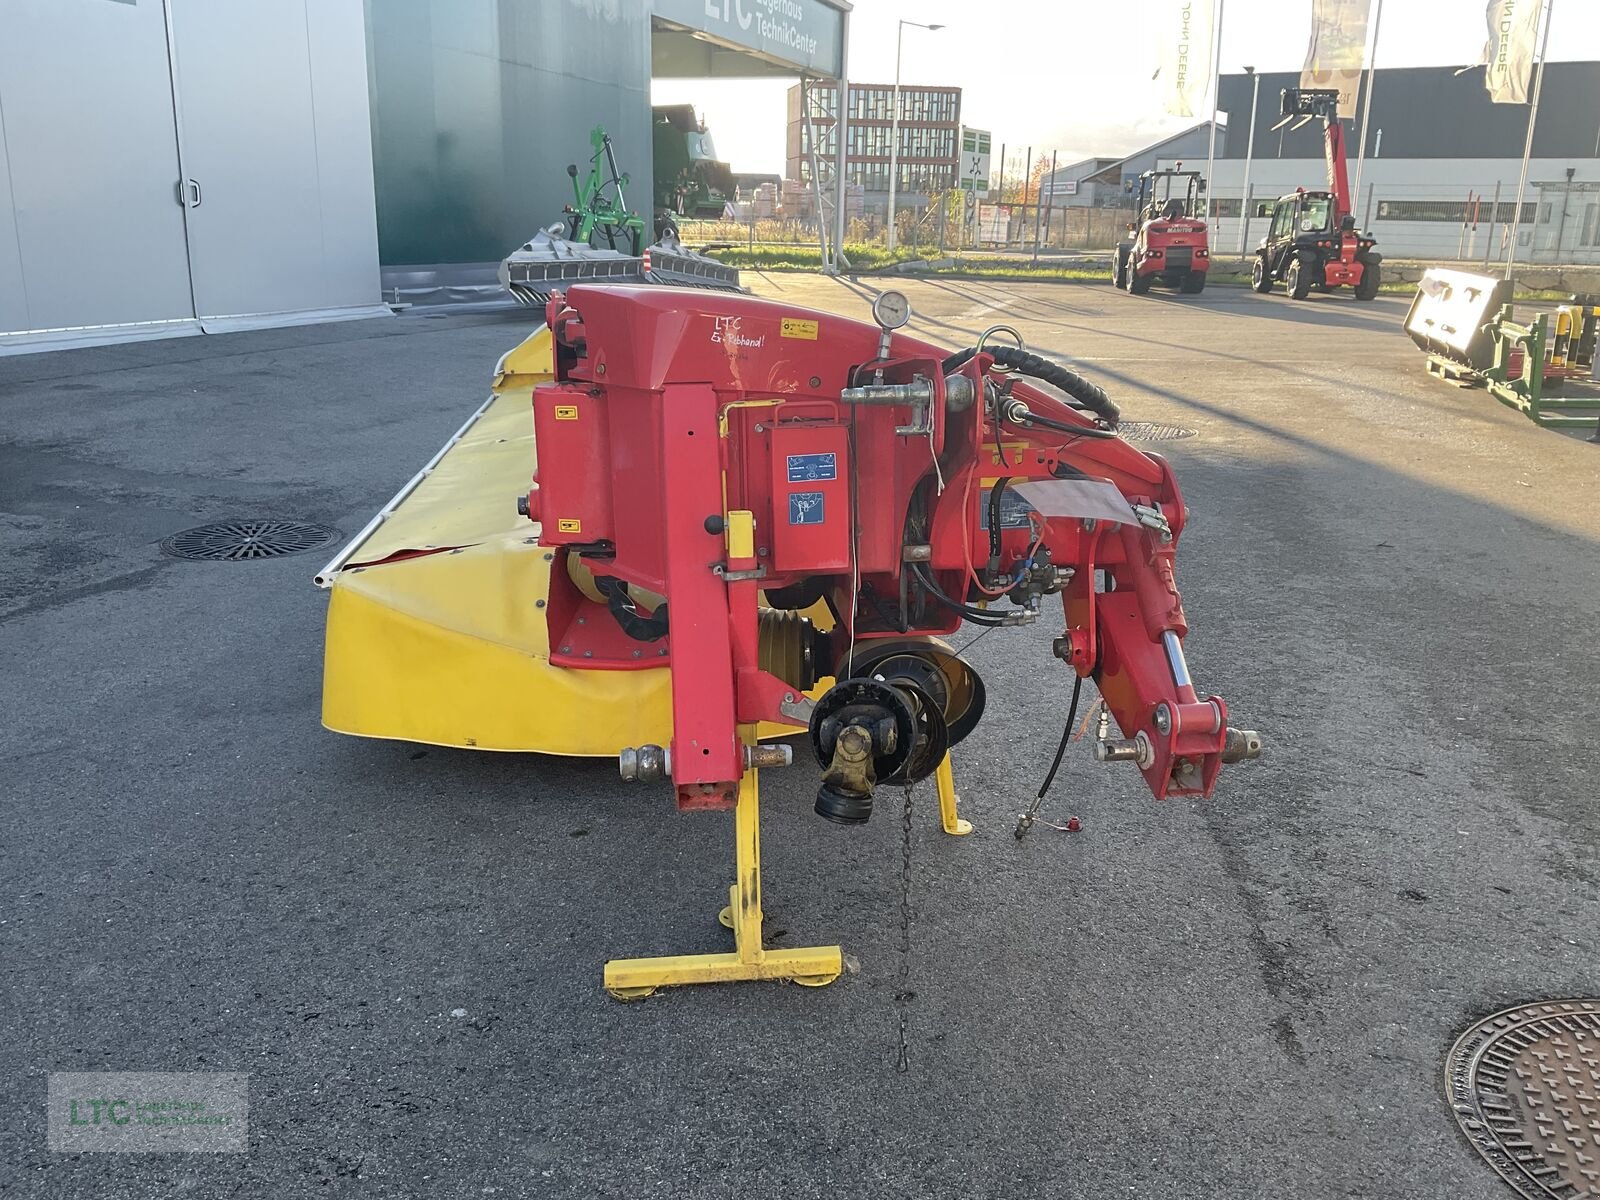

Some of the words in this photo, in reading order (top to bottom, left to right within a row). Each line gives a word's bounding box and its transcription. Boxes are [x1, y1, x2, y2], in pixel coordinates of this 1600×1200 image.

[756, 0, 803, 21] agerhaus
[756, 12, 817, 55] TechnikCenter
[715, 316, 742, 331] LTC
